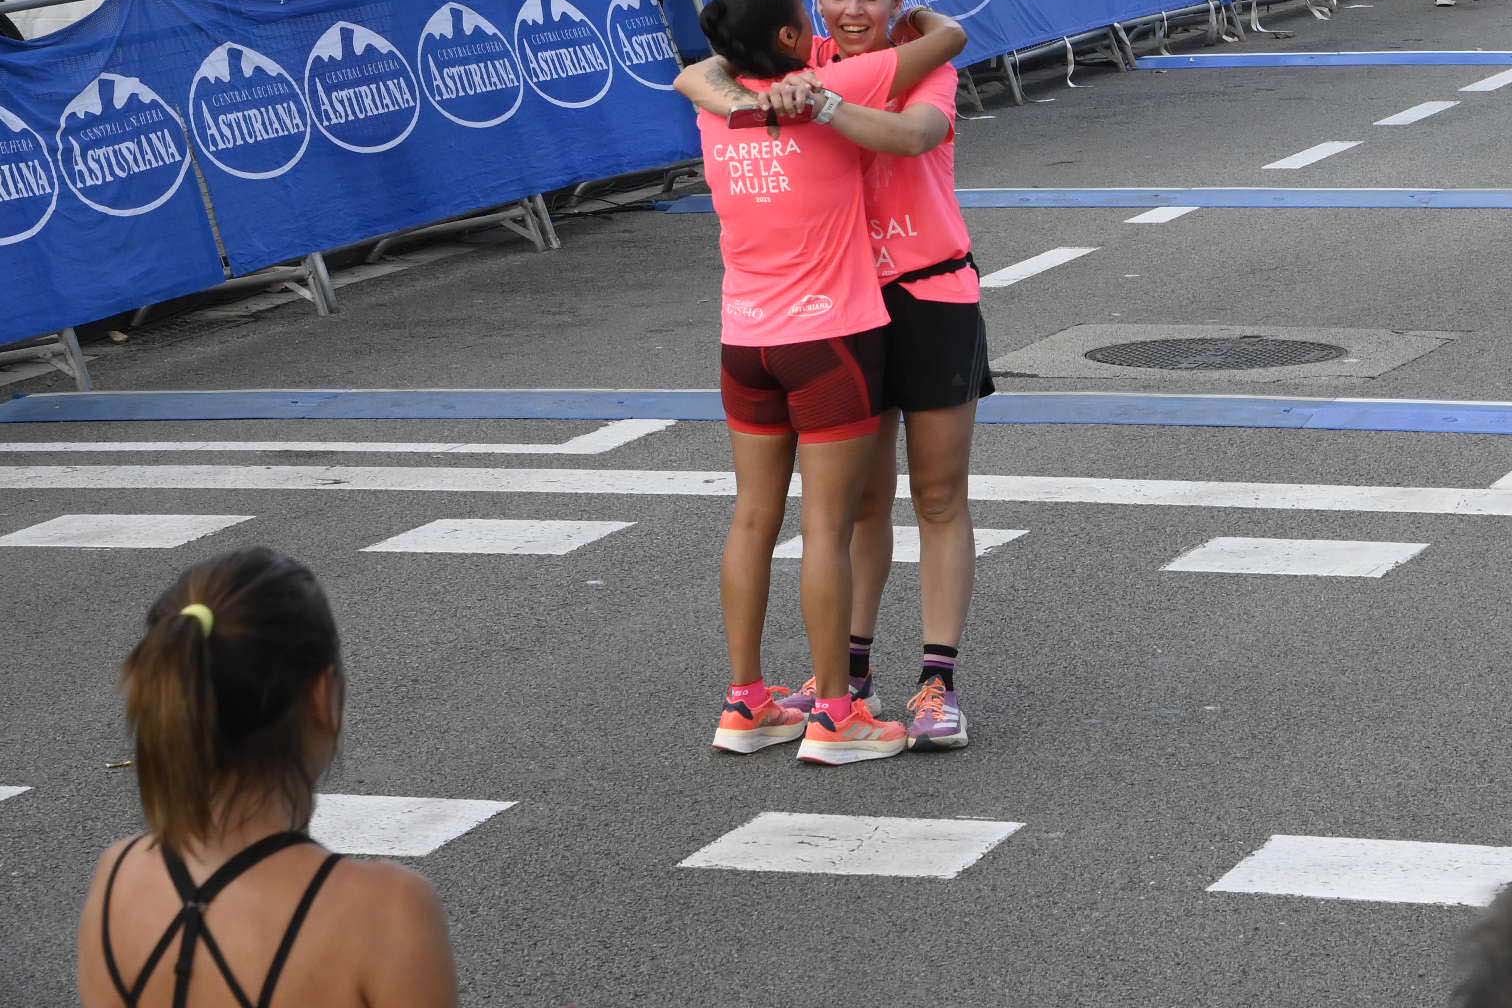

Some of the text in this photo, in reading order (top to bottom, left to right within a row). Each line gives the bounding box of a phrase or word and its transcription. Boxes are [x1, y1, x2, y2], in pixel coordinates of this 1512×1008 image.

[427, 53, 519, 102] ASTURIANA
[524, 38, 608, 84] ASTURIANA
[316, 76, 415, 127] ASTURIANA
[200, 99, 304, 152] ASTURIANA
[713, 138, 801, 161] CARRERA
[729, 160, 784, 178] DE LA
[729, 176, 792, 195] MUJER
